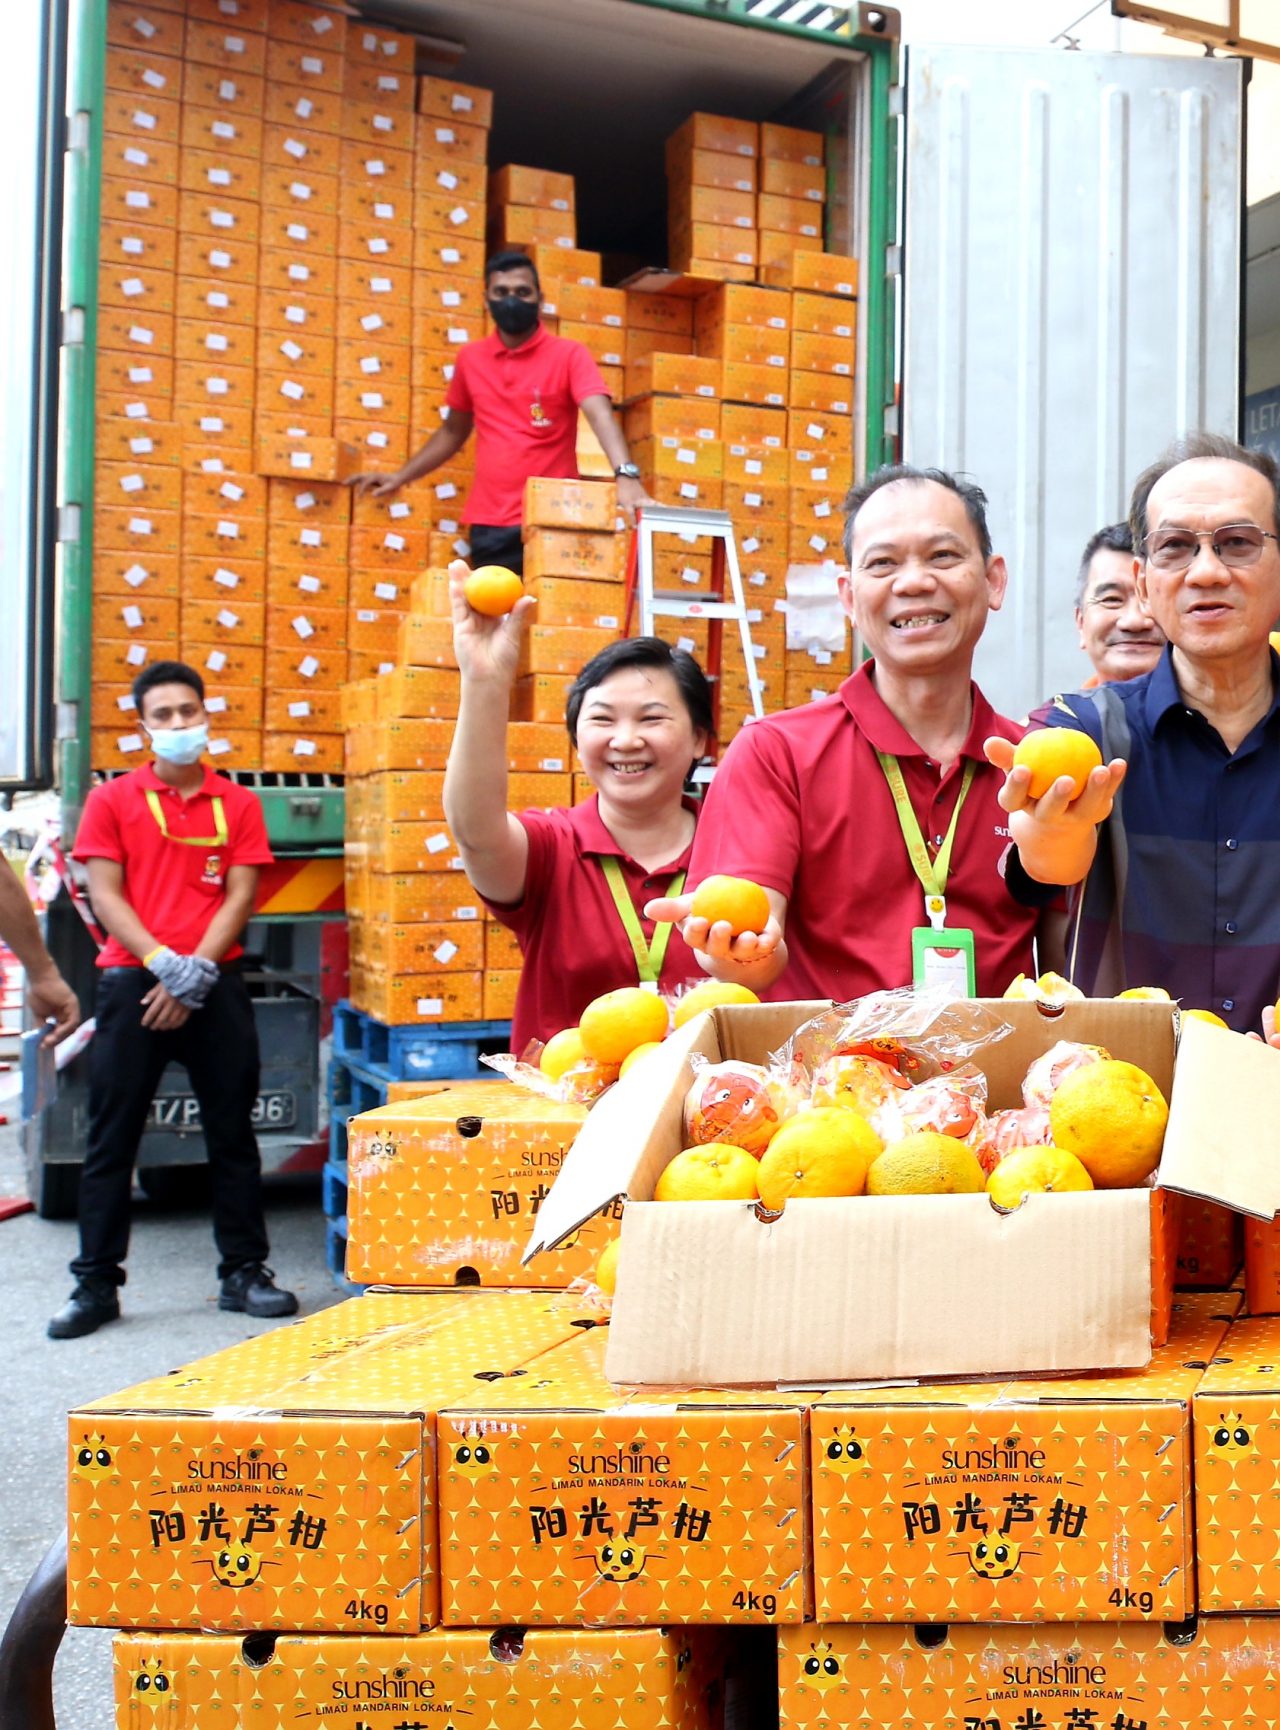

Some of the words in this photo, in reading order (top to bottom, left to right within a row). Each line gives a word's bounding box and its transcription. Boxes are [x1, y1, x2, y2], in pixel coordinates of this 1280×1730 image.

[188, 1456, 287, 1480] sunshine
[568, 1449, 670, 1474] sunshine
[942, 1444, 1046, 1470] sunshine
[171, 1486, 203, 1494] LIMAU
[207, 1484, 262, 1494] MANDARIN
[266, 1486, 304, 1497] LOKAM
[551, 1480, 583, 1489] LIMAU
[588, 1478, 644, 1487] MANDARIN
[649, 1480, 687, 1489] LOKAM
[925, 1476, 957, 1486] LIMAU
[962, 1474, 1019, 1483] MANDARIN
[1024, 1475, 1063, 1486] LOKAM
[148, 1502, 327, 1550] 阳光芦柑
[529, 1497, 712, 1544] 阳光芦柑
[902, 1492, 1088, 1540] 阳光芦柑
[345, 1600, 388, 1625] 4kg
[733, 1592, 776, 1615] 4kg
[1109, 1588, 1152, 1613] 4kg
[1003, 1660, 1106, 1684] sunshine
[332, 1674, 435, 1700] sunshine
[986, 1691, 1019, 1700] LIMAU
[1023, 1689, 1080, 1699] MANDARIN
[1085, 1689, 1123, 1700] LOKAM
[316, 1705, 349, 1714] LIMAU
[353, 1703, 410, 1712] MANDARIN
[413, 1703, 452, 1713] LOKAM
